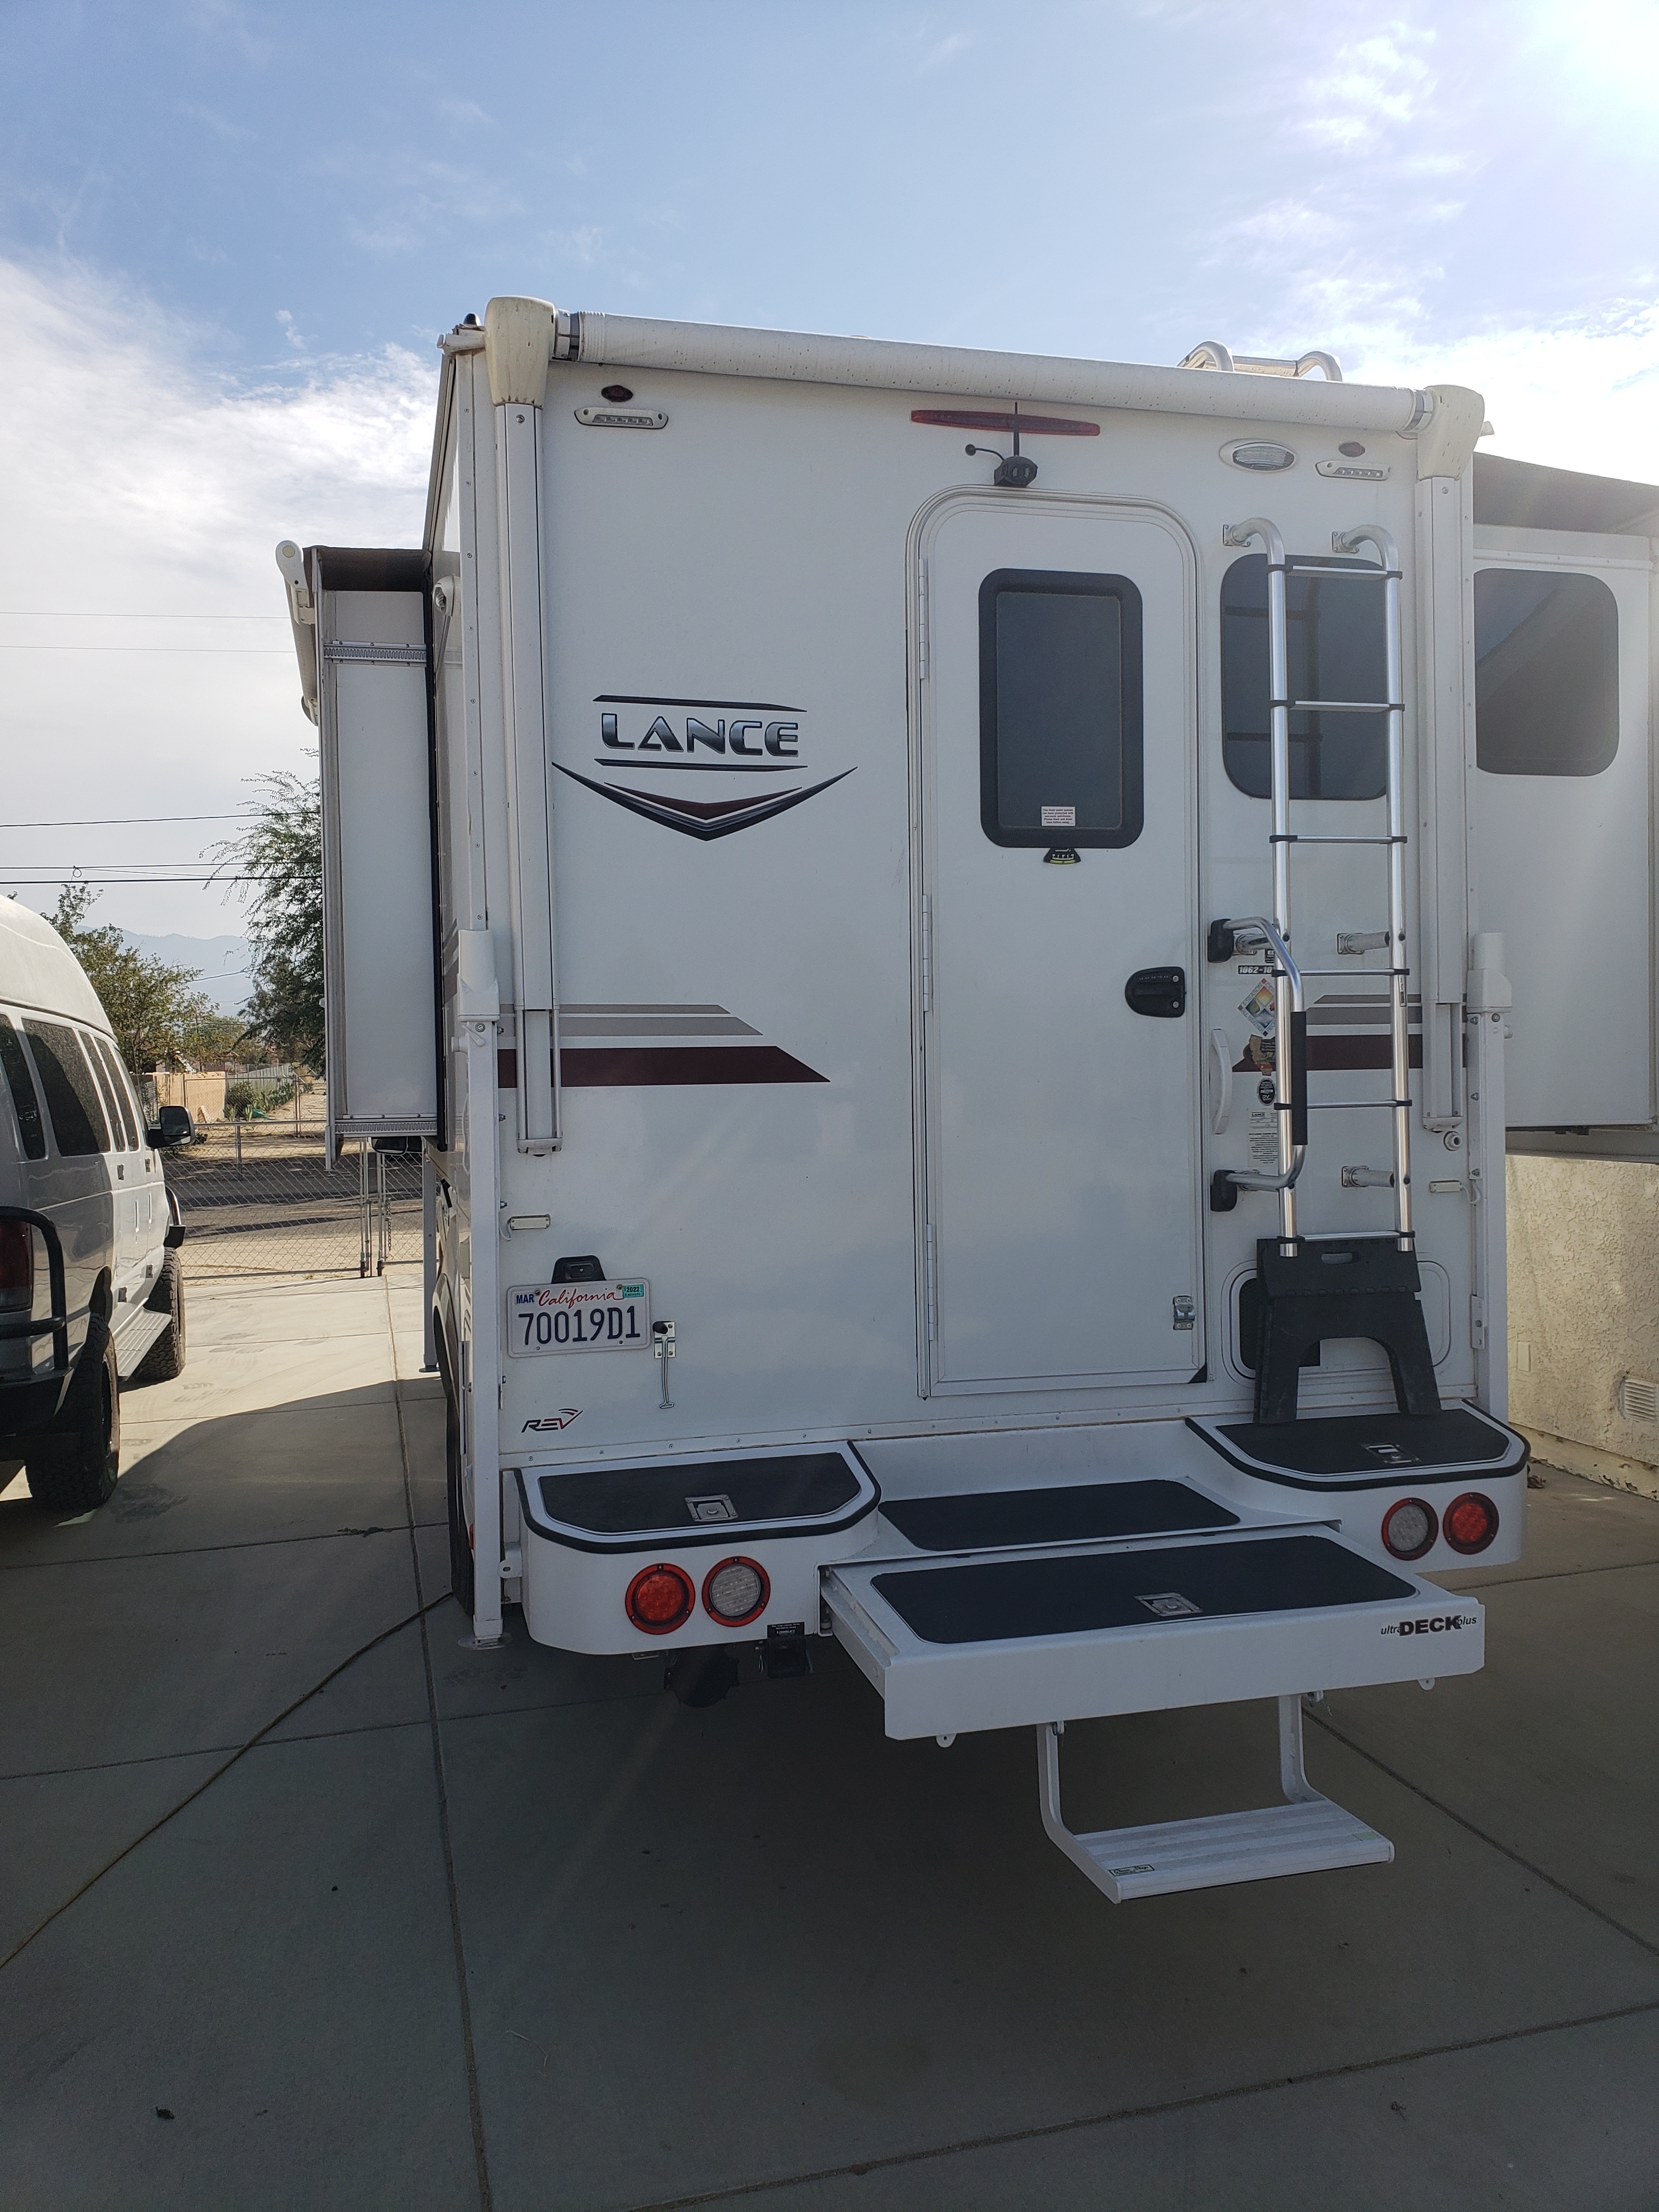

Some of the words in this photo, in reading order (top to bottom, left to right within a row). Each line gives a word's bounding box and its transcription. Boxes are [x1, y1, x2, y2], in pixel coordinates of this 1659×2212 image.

[601, 712, 799, 757] LANCE
[516, 1293, 535, 1305] MAR
[538, 1288, 624, 1309] California
[518, 1305, 641, 1346] 70019D1
[521, 1409, 583, 1433] REV
